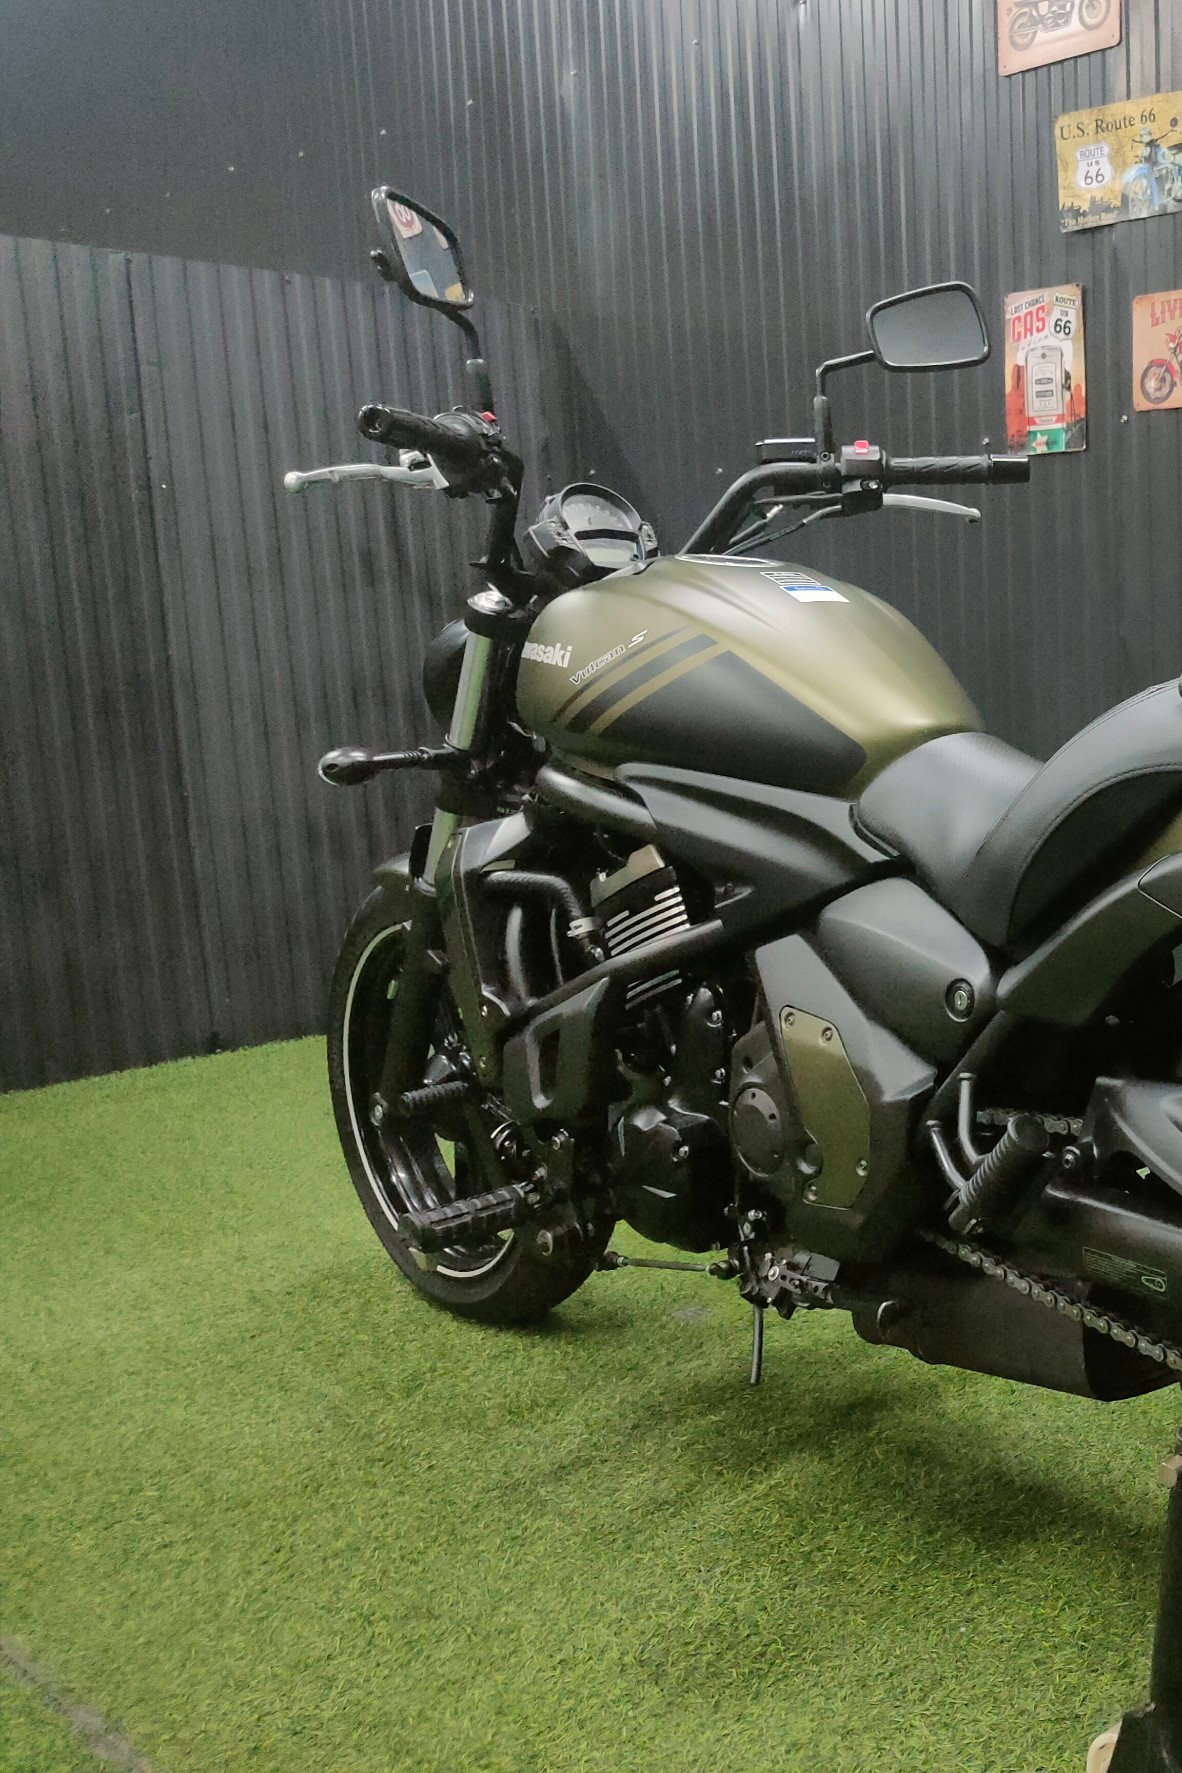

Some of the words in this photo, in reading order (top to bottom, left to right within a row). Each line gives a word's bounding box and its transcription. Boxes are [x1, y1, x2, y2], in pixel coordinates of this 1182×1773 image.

[1059, 122, 1090, 140] U.S.
[1095, 116, 1135, 135] Route
[1140, 108, 1156, 125] 66
[1080, 146, 1105, 159] ROUTE
[1084, 168, 1105, 186] 66
[1010, 304, 1023, 316] LAST
[1025, 296, 1045, 310] CHANCE
[1055, 296, 1076, 307] ROUTE
[1011, 305, 1046, 343] GAS
[1054, 318, 1072, 335] 66
[628, 629, 648, 648] S
[521, 641, 573, 668] wasaki
